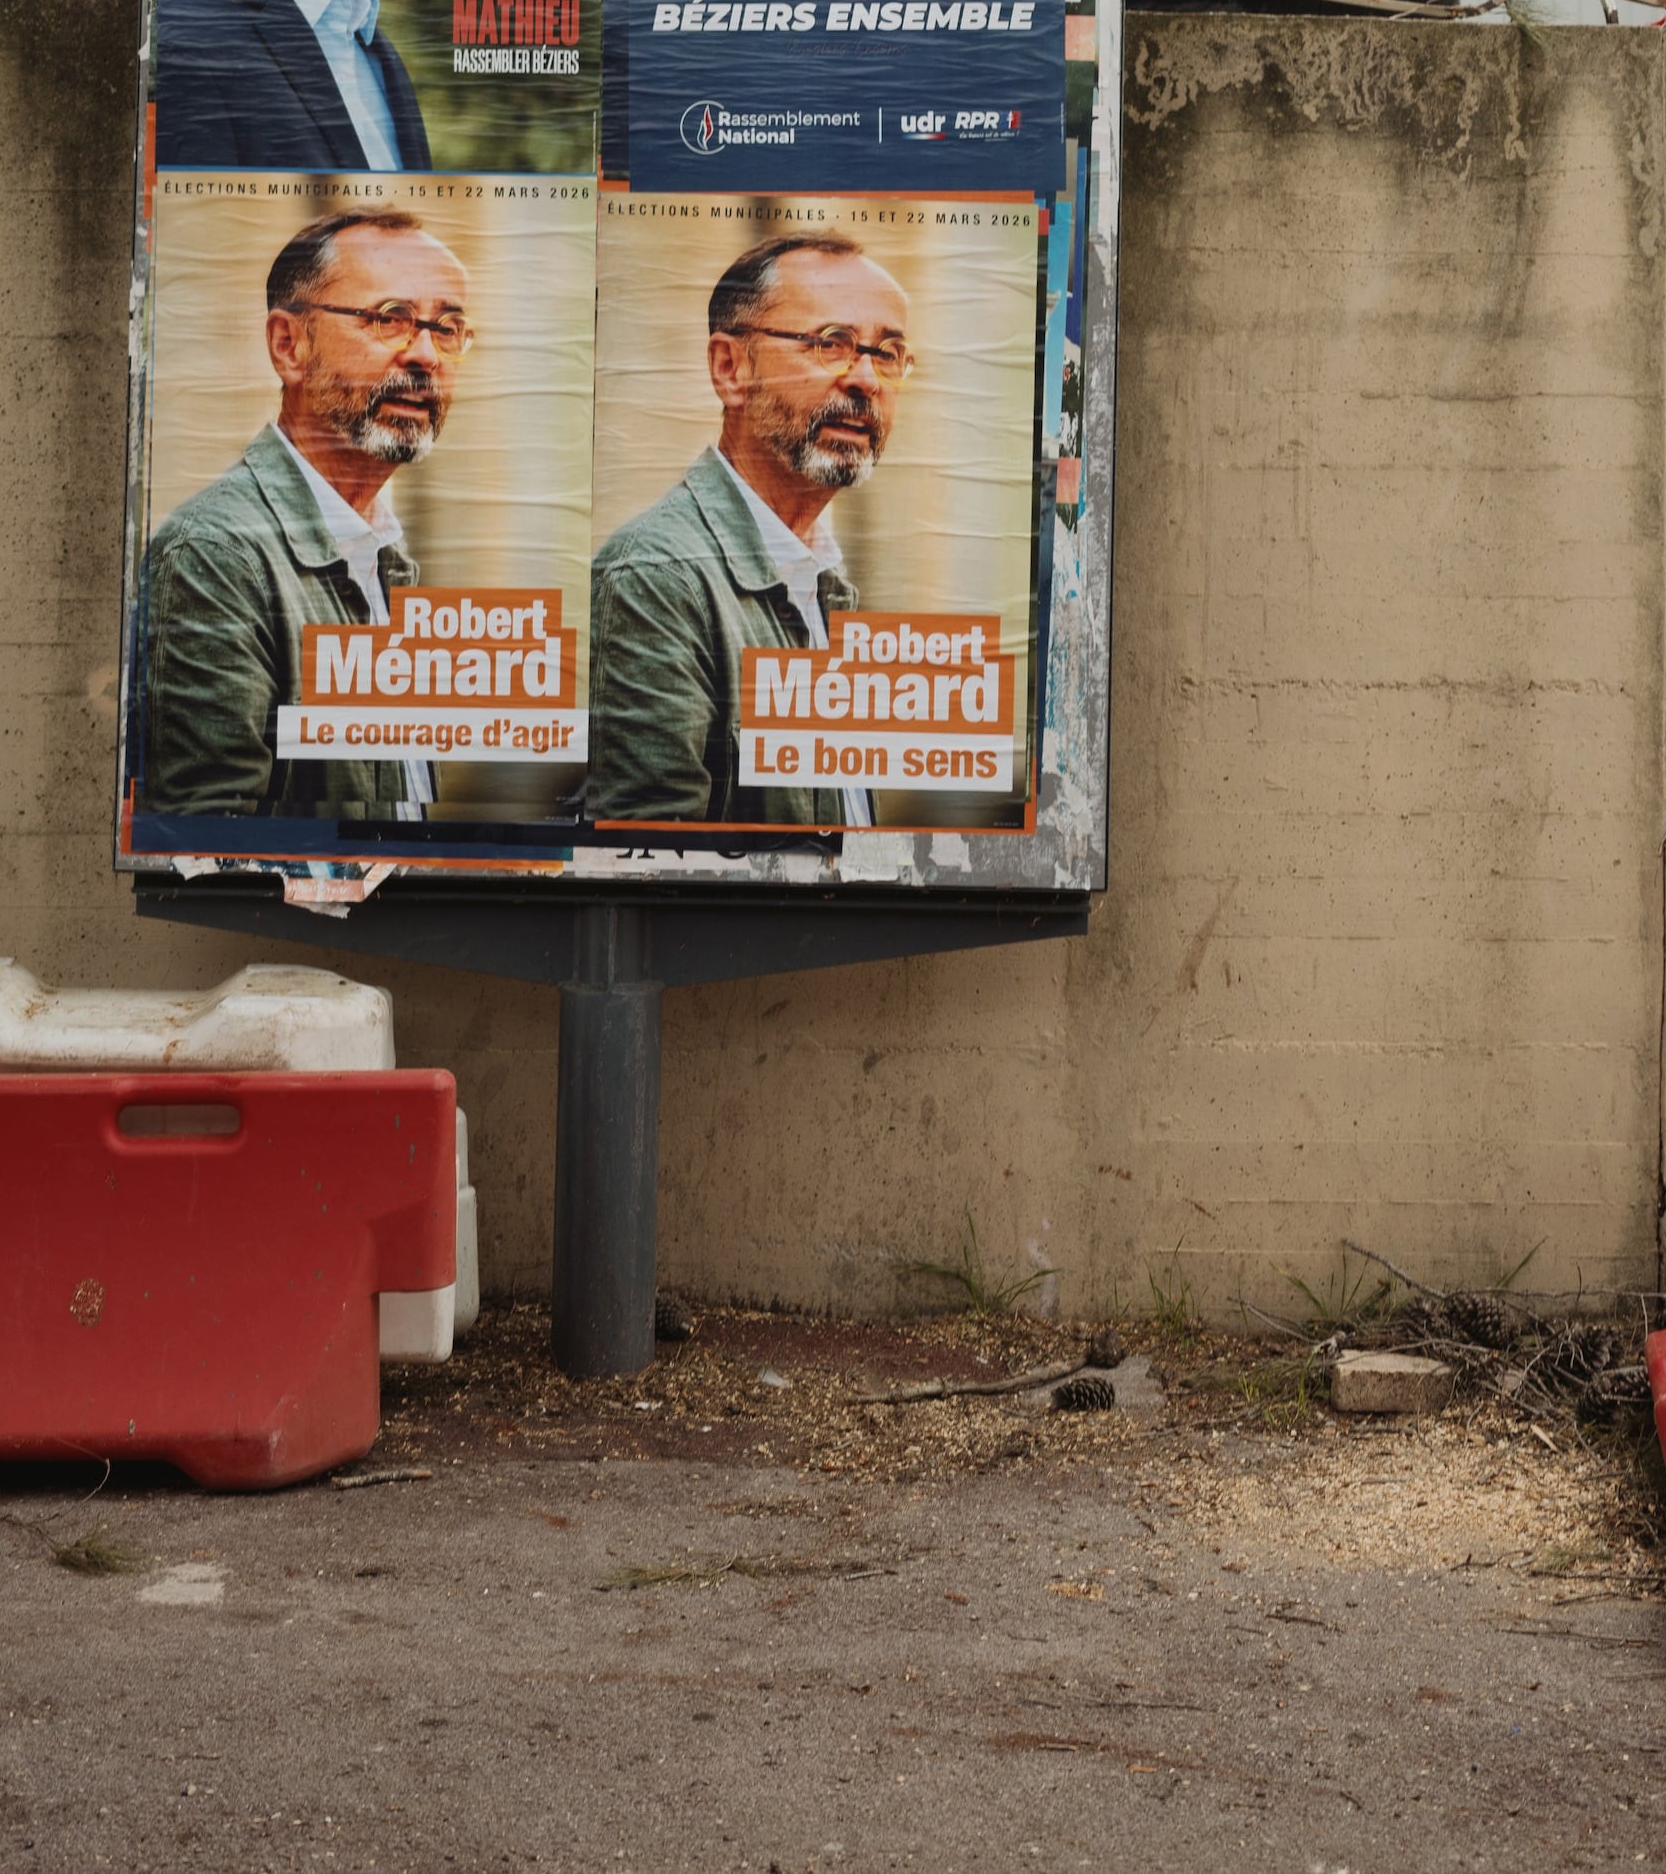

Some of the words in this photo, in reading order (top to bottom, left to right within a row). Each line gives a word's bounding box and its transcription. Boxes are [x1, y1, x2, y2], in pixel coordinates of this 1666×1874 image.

[825, 1, 1036, 31] ENSEMBLE
[453, 48, 530, 74] RASSEMBLER
[533, 44, 580, 75] BÉZIERS
[718, 110, 861, 128] Rassemblement
[900, 110, 946, 133] udr
[954, 111, 1001, 130] RPR
[718, 127, 796, 145] National
[163, 179, 258, 195] ÉLECTIONS
[267, 183, 384, 197] MUNICIPALES
[408, 186, 427, 197] 15
[437, 186, 455, 198] ET
[465, 186, 484, 198] 22
[494, 187, 540, 199] MARS
[550, 187, 590, 199] 2026
[607, 201, 700, 218] ÉLECTIONS
[710, 205, 826, 221] MUNICIPALES
[850, 210, 869, 223] 15
[879, 211, 896, 223] ET
[906, 212, 925, 224] 22
[935, 213, 981, 226] MARS
[991, 214, 1031, 227] 2026
[403, 597, 548, 639] Robert
[842, 621, 986, 665] Robert
[314, 633, 562, 697] Ménard
[754, 657, 1000, 723] Ménard
[299, 716, 334, 745] Le
[344, 723, 472, 753] courage
[754, 735, 800, 775] Le
[814, 737, 889, 777] bon
[902, 747, 998, 779] sens
